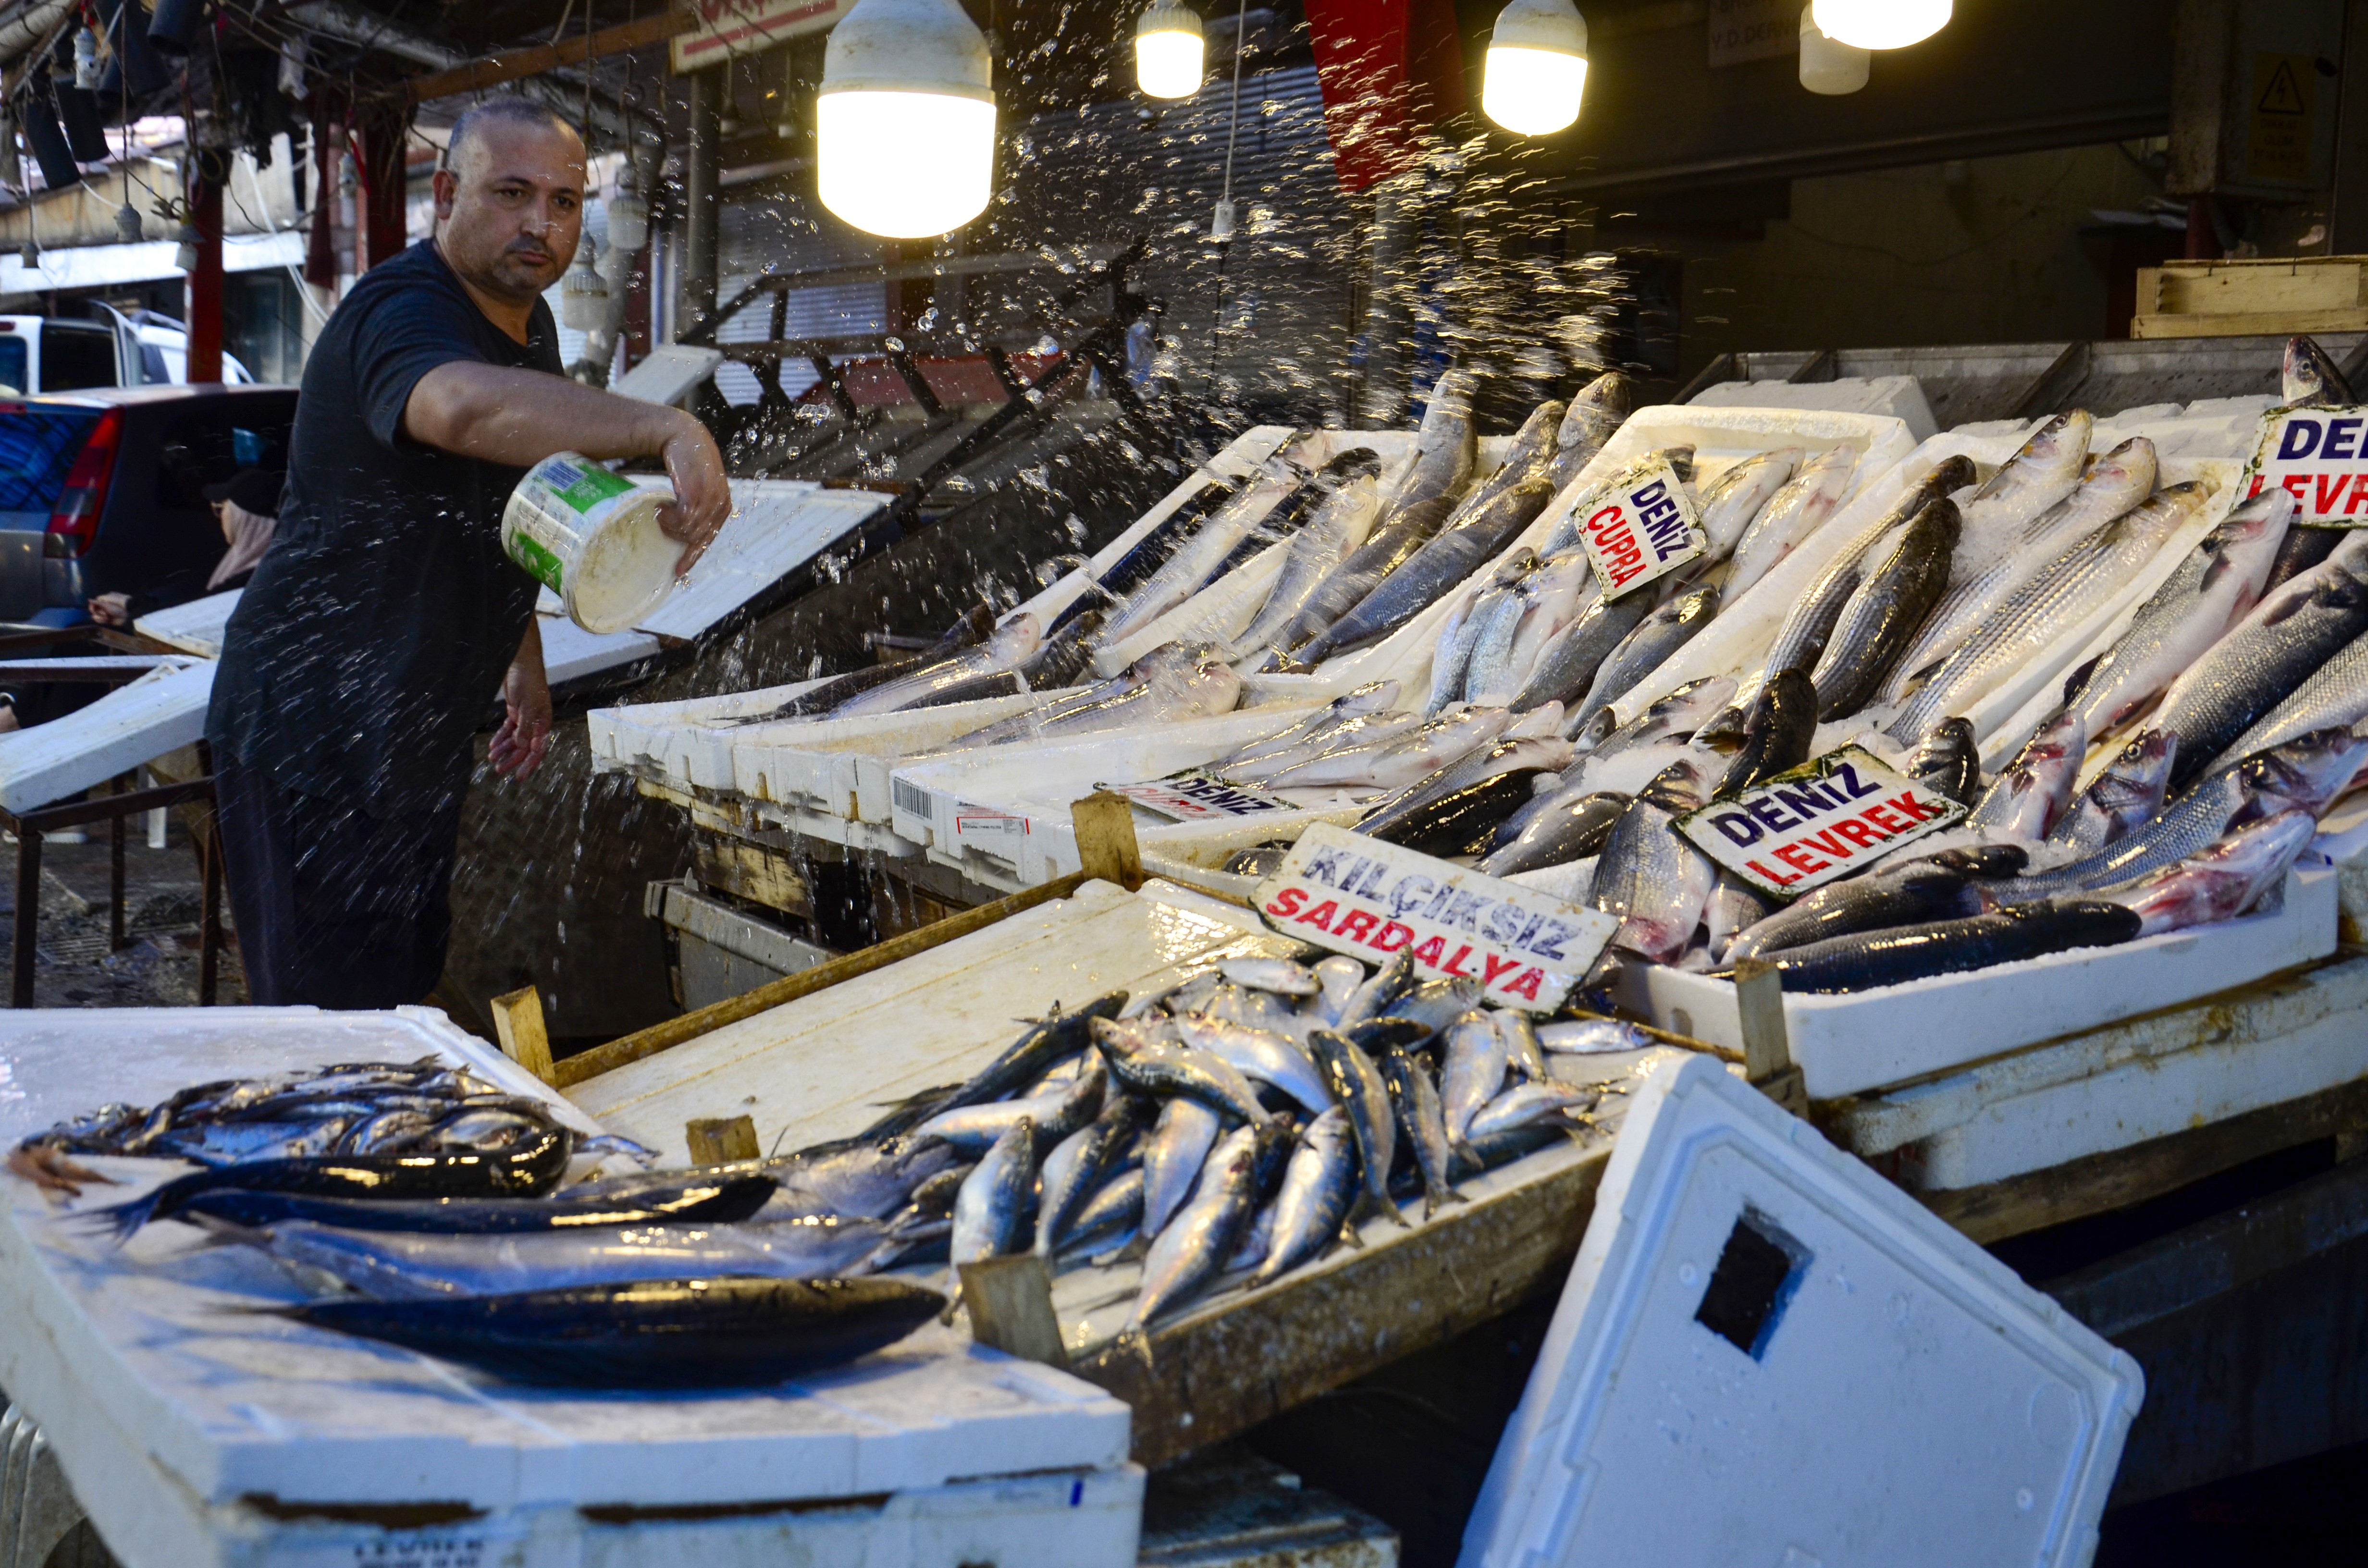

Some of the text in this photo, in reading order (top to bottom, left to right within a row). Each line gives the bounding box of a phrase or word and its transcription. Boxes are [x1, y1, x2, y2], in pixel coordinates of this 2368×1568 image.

[2277, 418, 2368, 460] DE
[1579, 506, 1647, 589] ÇUPRA
[1630, 478, 1694, 563] DENİZ
[1745, 790, 1946, 885] LEVREK
[1266, 888, 1545, 1001] SARDALYA
[1301, 845, 1581, 961] KILÇIKSIZ
